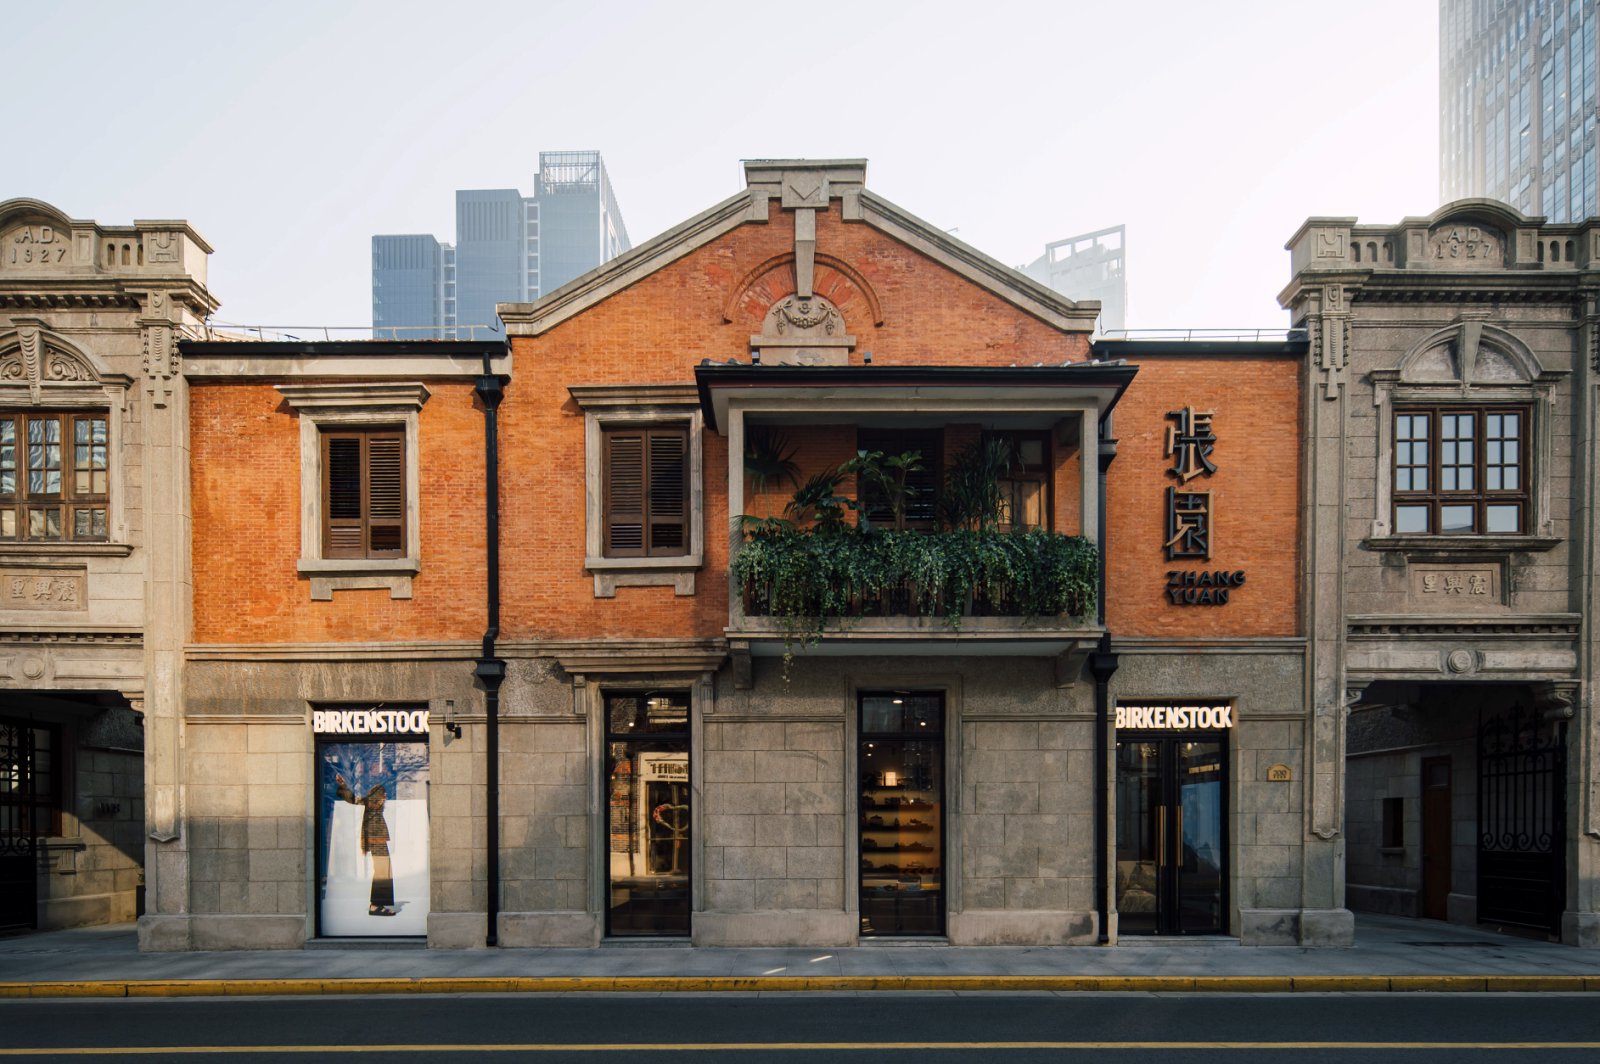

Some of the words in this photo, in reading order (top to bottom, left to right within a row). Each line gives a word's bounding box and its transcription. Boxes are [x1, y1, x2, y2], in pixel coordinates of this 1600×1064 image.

[12, 247, 66, 265] 1927
[1438, 244, 1492, 260] 1927
[1168, 570, 1245, 586] ZHANG
[1168, 587, 1229, 605] YUAN
[313, 710, 430, 733] BIRKENSTOCK
[1115, 706, 1233, 729] BIRKENSTOCK
